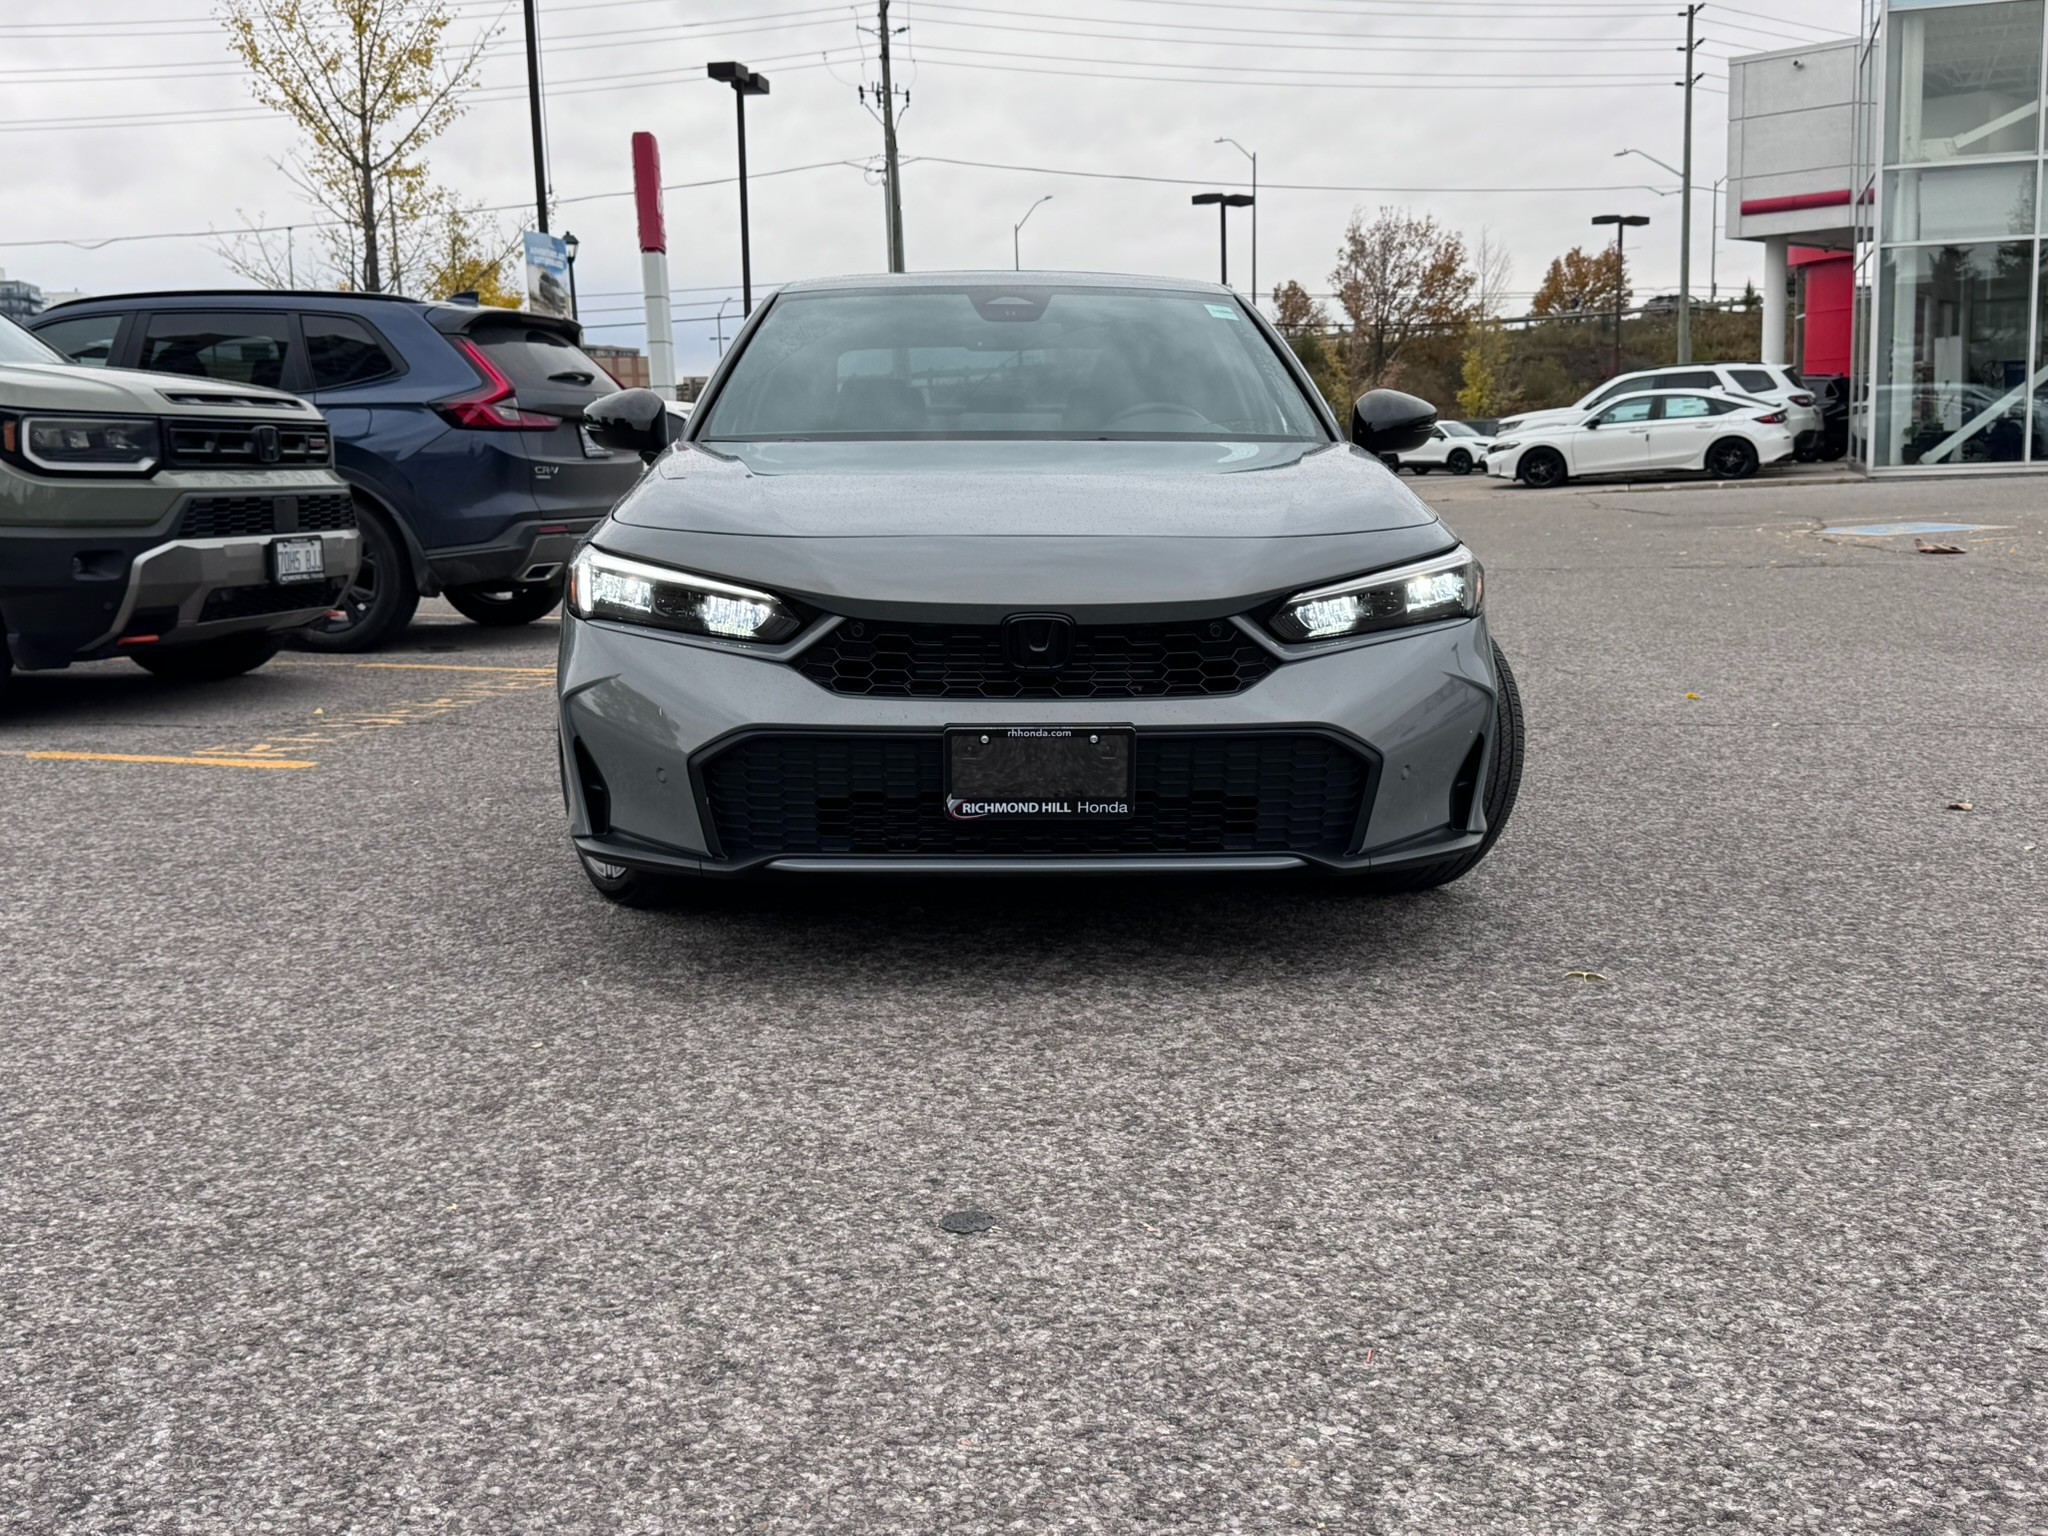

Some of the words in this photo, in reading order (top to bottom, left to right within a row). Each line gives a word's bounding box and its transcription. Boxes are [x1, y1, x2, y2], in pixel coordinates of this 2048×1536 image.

[1007, 728, 1072, 737] rhhonda.com
[962, 802, 1039, 814] RICHMOND
[1042, 802, 1071, 813] HILL
[1077, 801, 1128, 813] Honda
